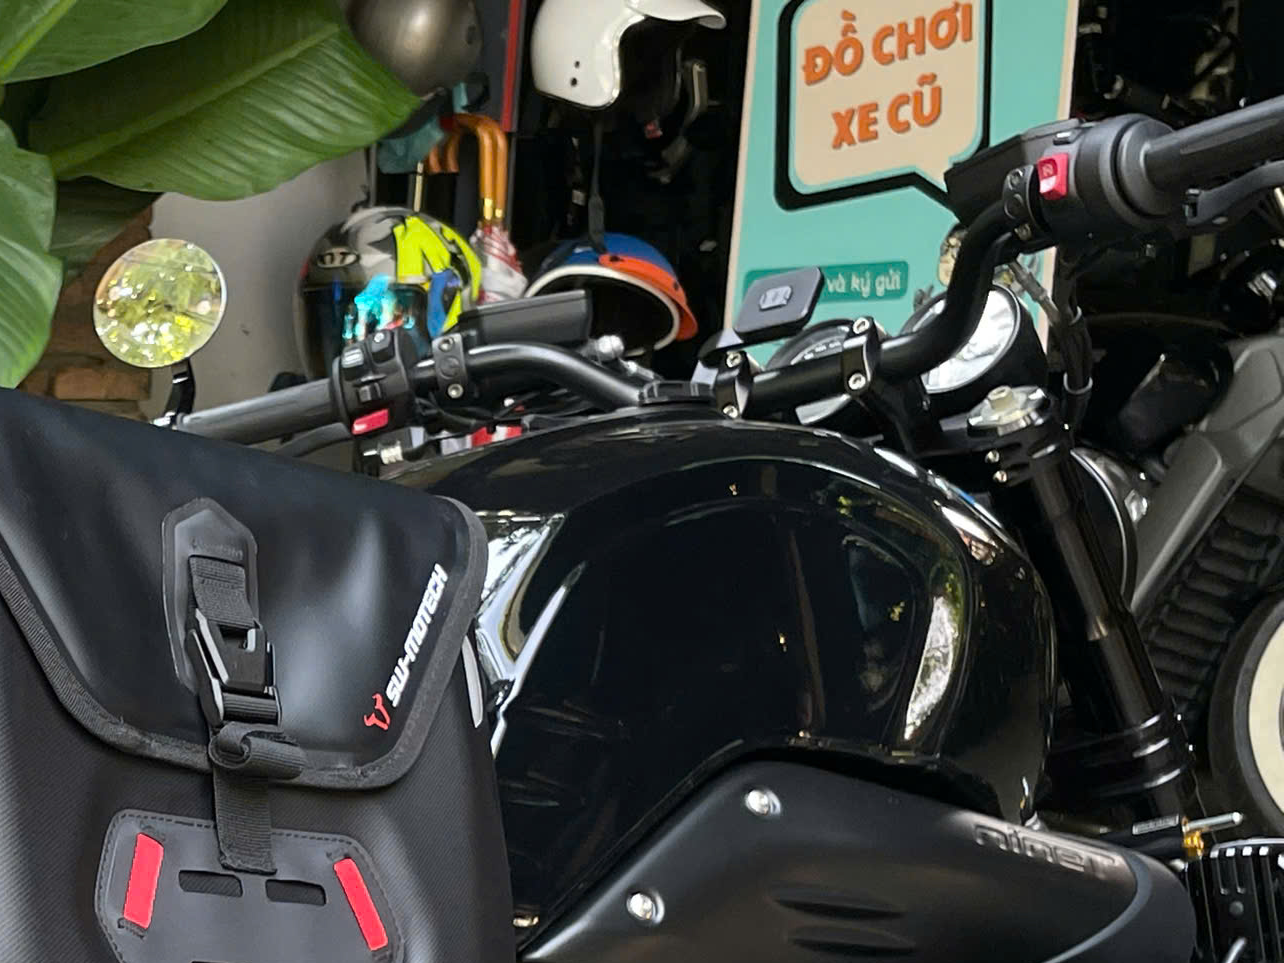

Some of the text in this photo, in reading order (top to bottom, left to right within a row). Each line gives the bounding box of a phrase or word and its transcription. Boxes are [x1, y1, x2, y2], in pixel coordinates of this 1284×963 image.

[802, 1, 972, 86] ĐỒ CHƠI
[832, 73, 942, 150] XE CŨ
[386, 563, 448, 707] SW-MOTECH
